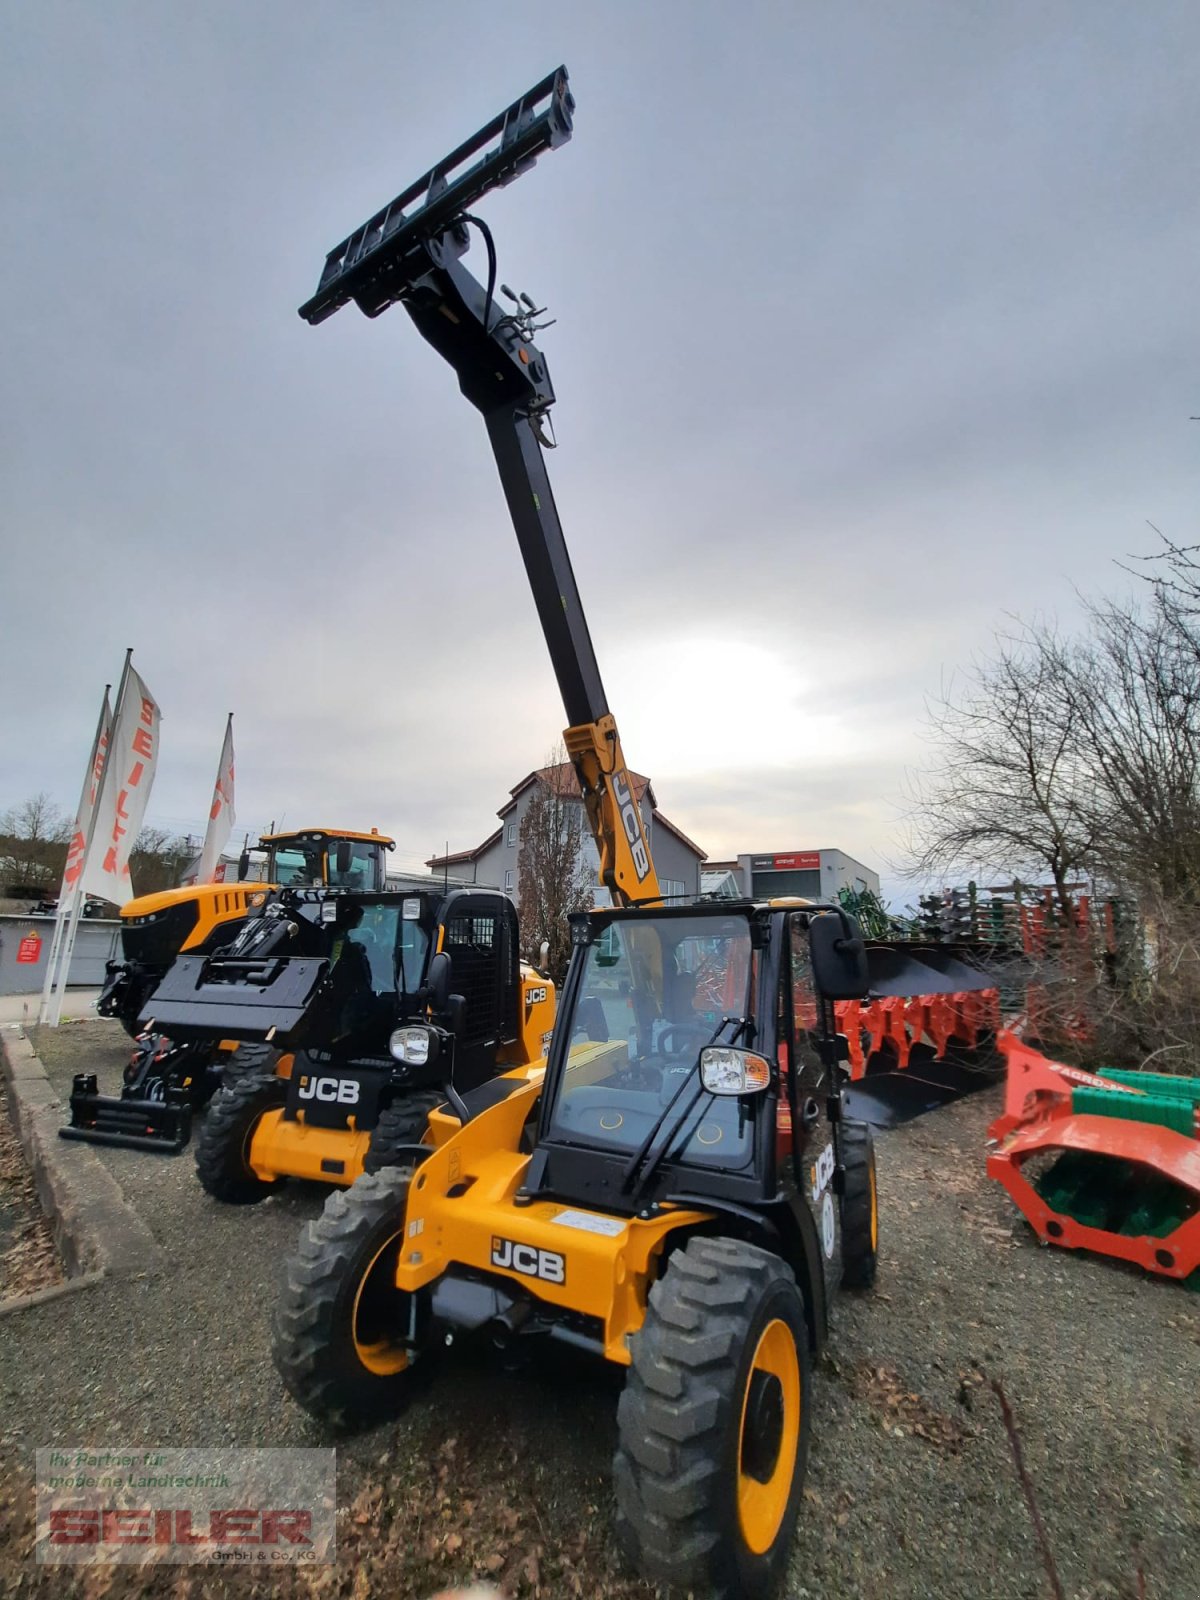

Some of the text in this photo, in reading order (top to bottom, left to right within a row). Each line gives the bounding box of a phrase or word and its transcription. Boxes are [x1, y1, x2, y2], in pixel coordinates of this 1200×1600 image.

[612, 774, 650, 879] JCB
[525, 987, 547, 1005] JCB
[298, 1075, 361, 1105] JCB
[811, 1143, 835, 1201] JCB
[491, 1238, 566, 1284] JCB
